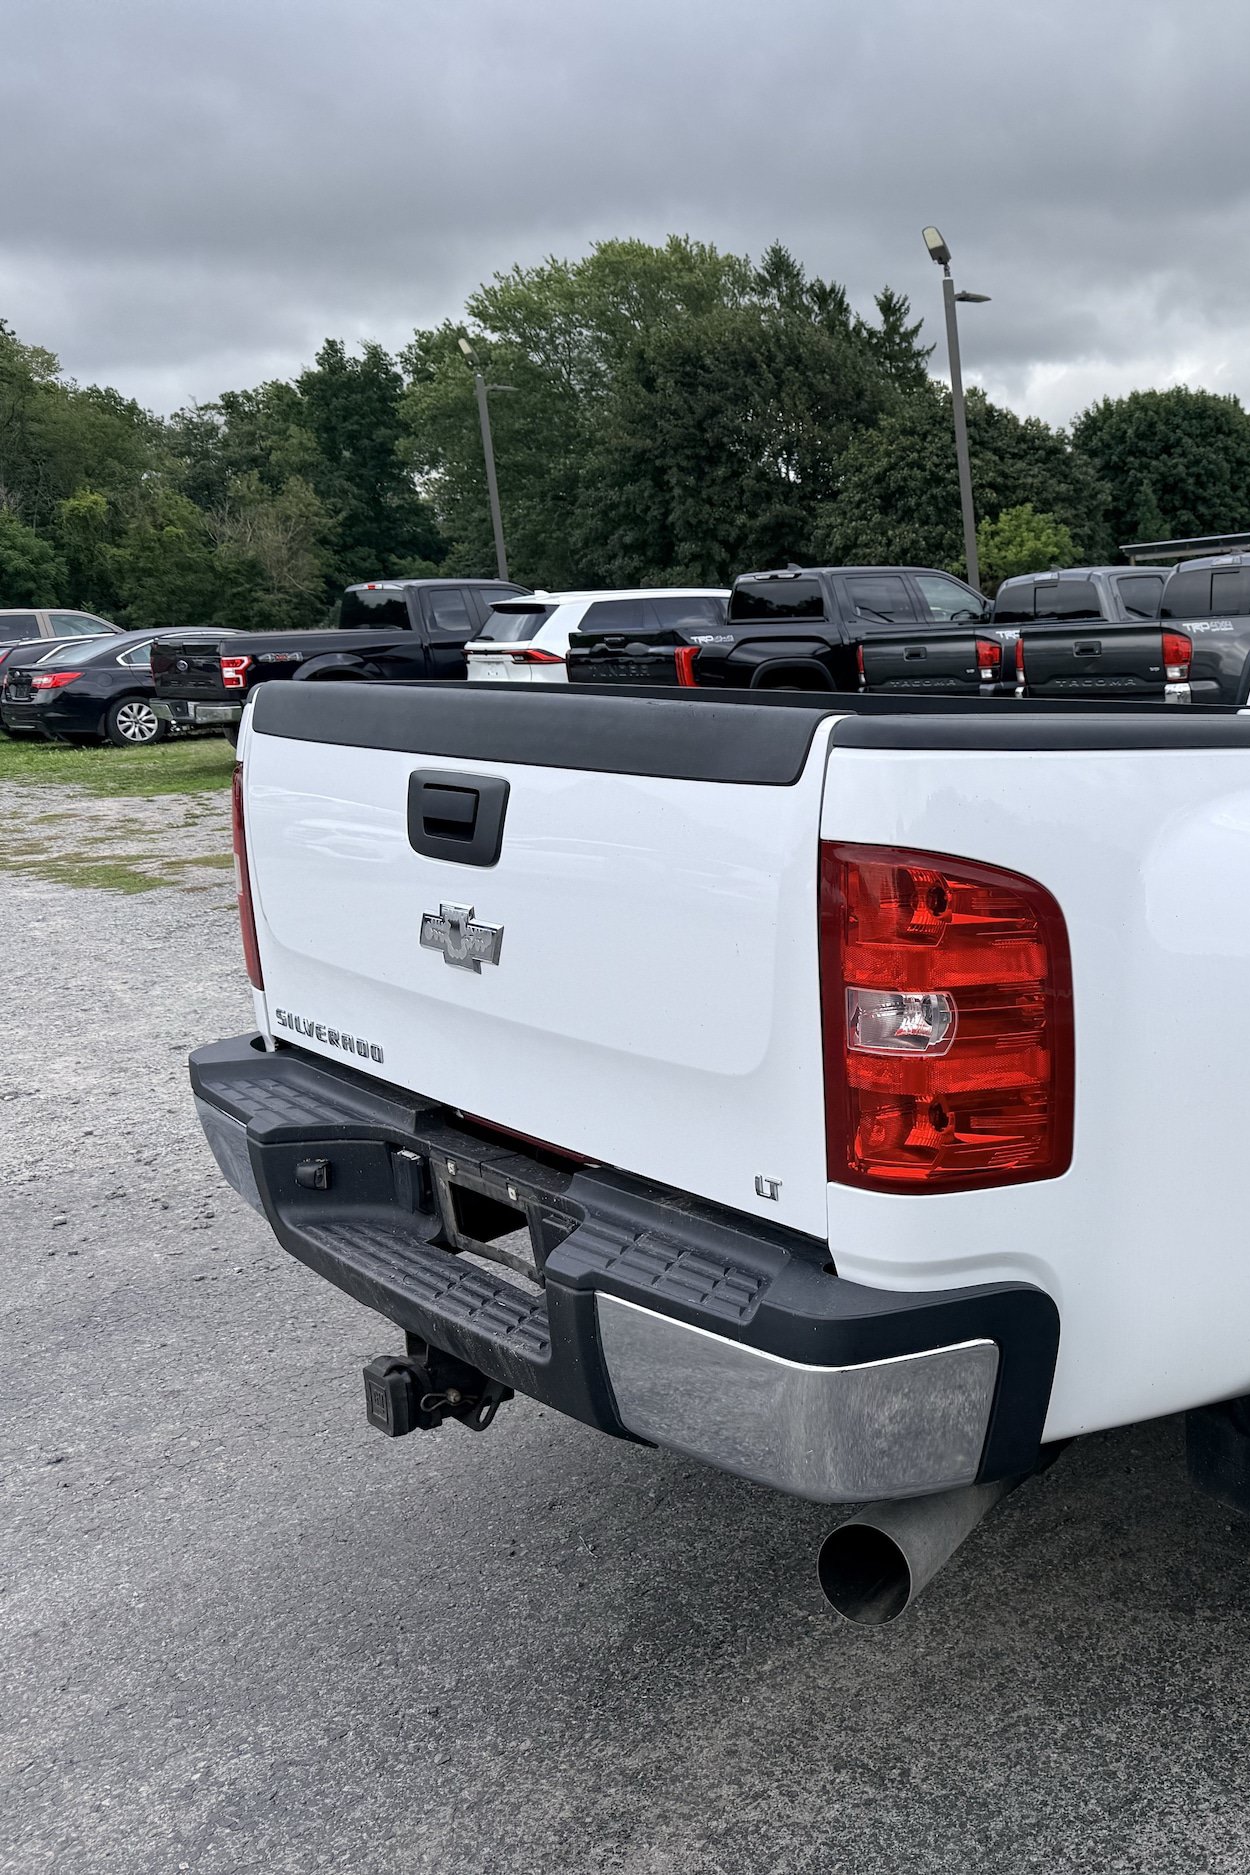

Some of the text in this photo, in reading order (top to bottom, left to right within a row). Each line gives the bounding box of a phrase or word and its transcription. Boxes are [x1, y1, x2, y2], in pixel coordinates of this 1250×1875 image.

[1183, 622, 1210, 633] TRD
[690, 635, 714, 644] TRD
[889, 680, 957, 688] TACOMA
[1055, 678, 1137, 688] TACOMA
[275, 1007, 385, 1065] SILVERADO
[754, 1174, 783, 1202] LT
